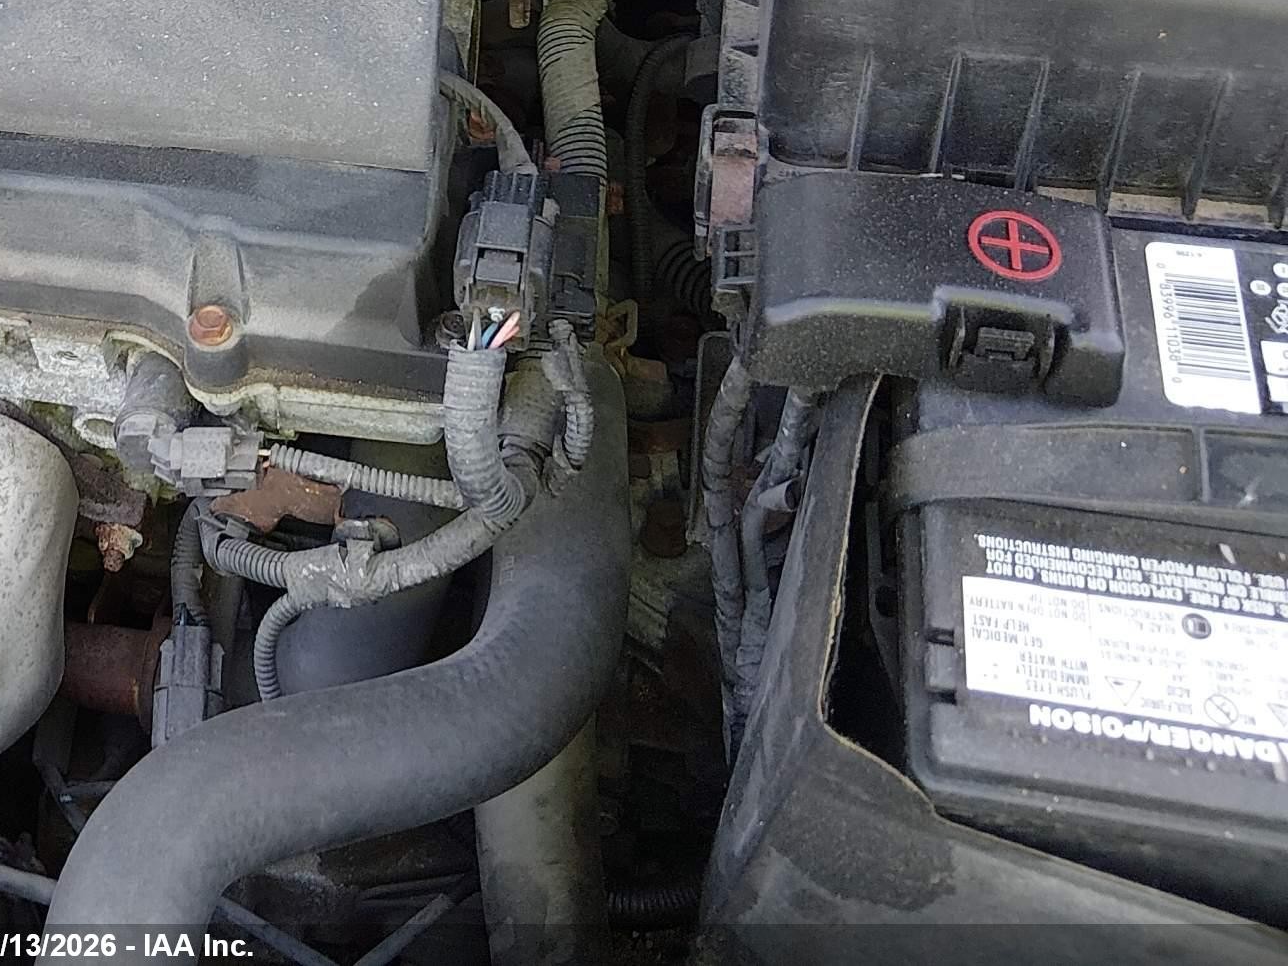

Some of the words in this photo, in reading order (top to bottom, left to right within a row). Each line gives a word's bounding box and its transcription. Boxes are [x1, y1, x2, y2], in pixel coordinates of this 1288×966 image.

[1159, 282, 1175, 320] 83996
[1165, 326, 1182, 363] 11038
[973, 534, 1070, 559] INSTRUCTIONS.
[985, 548, 1013, 563] FOR
[1014, 552, 1114, 579] RECOMMENDED
[1071, 547, 1139, 569] CHARGING
[1140, 557, 1194, 577] PROPER
[985, 560, 1012, 577] NOT
[1014, 563, 1035, 581] DO
[1115, 565, 1143, 583] NOT
[1196, 564, 1251, 586] FOLLOW
[1086, 574, 1108, 592] OR
[1108, 578, 1184, 602] EXPLOSION
[1221, 595, 1241, 611] OF
[1241, 598, 1276, 617] RISK
[971, 614, 1000, 627] FAST
[1002, 618, 1031, 634] HELP
[970, 626, 1019, 645] MEDICAL
[1021, 635, 1044, 649] GET
[1019, 650, 1056, 667] WATER
[1061, 658, 1089, 672] WITH
[1015, 664, 1090, 687] IMMEDIATELY
[1025, 679, 1053, 695] EYES
[1056, 684, 1092, 701] FLUSH
[1029, 703, 1281, 764] DANGER/POISON
